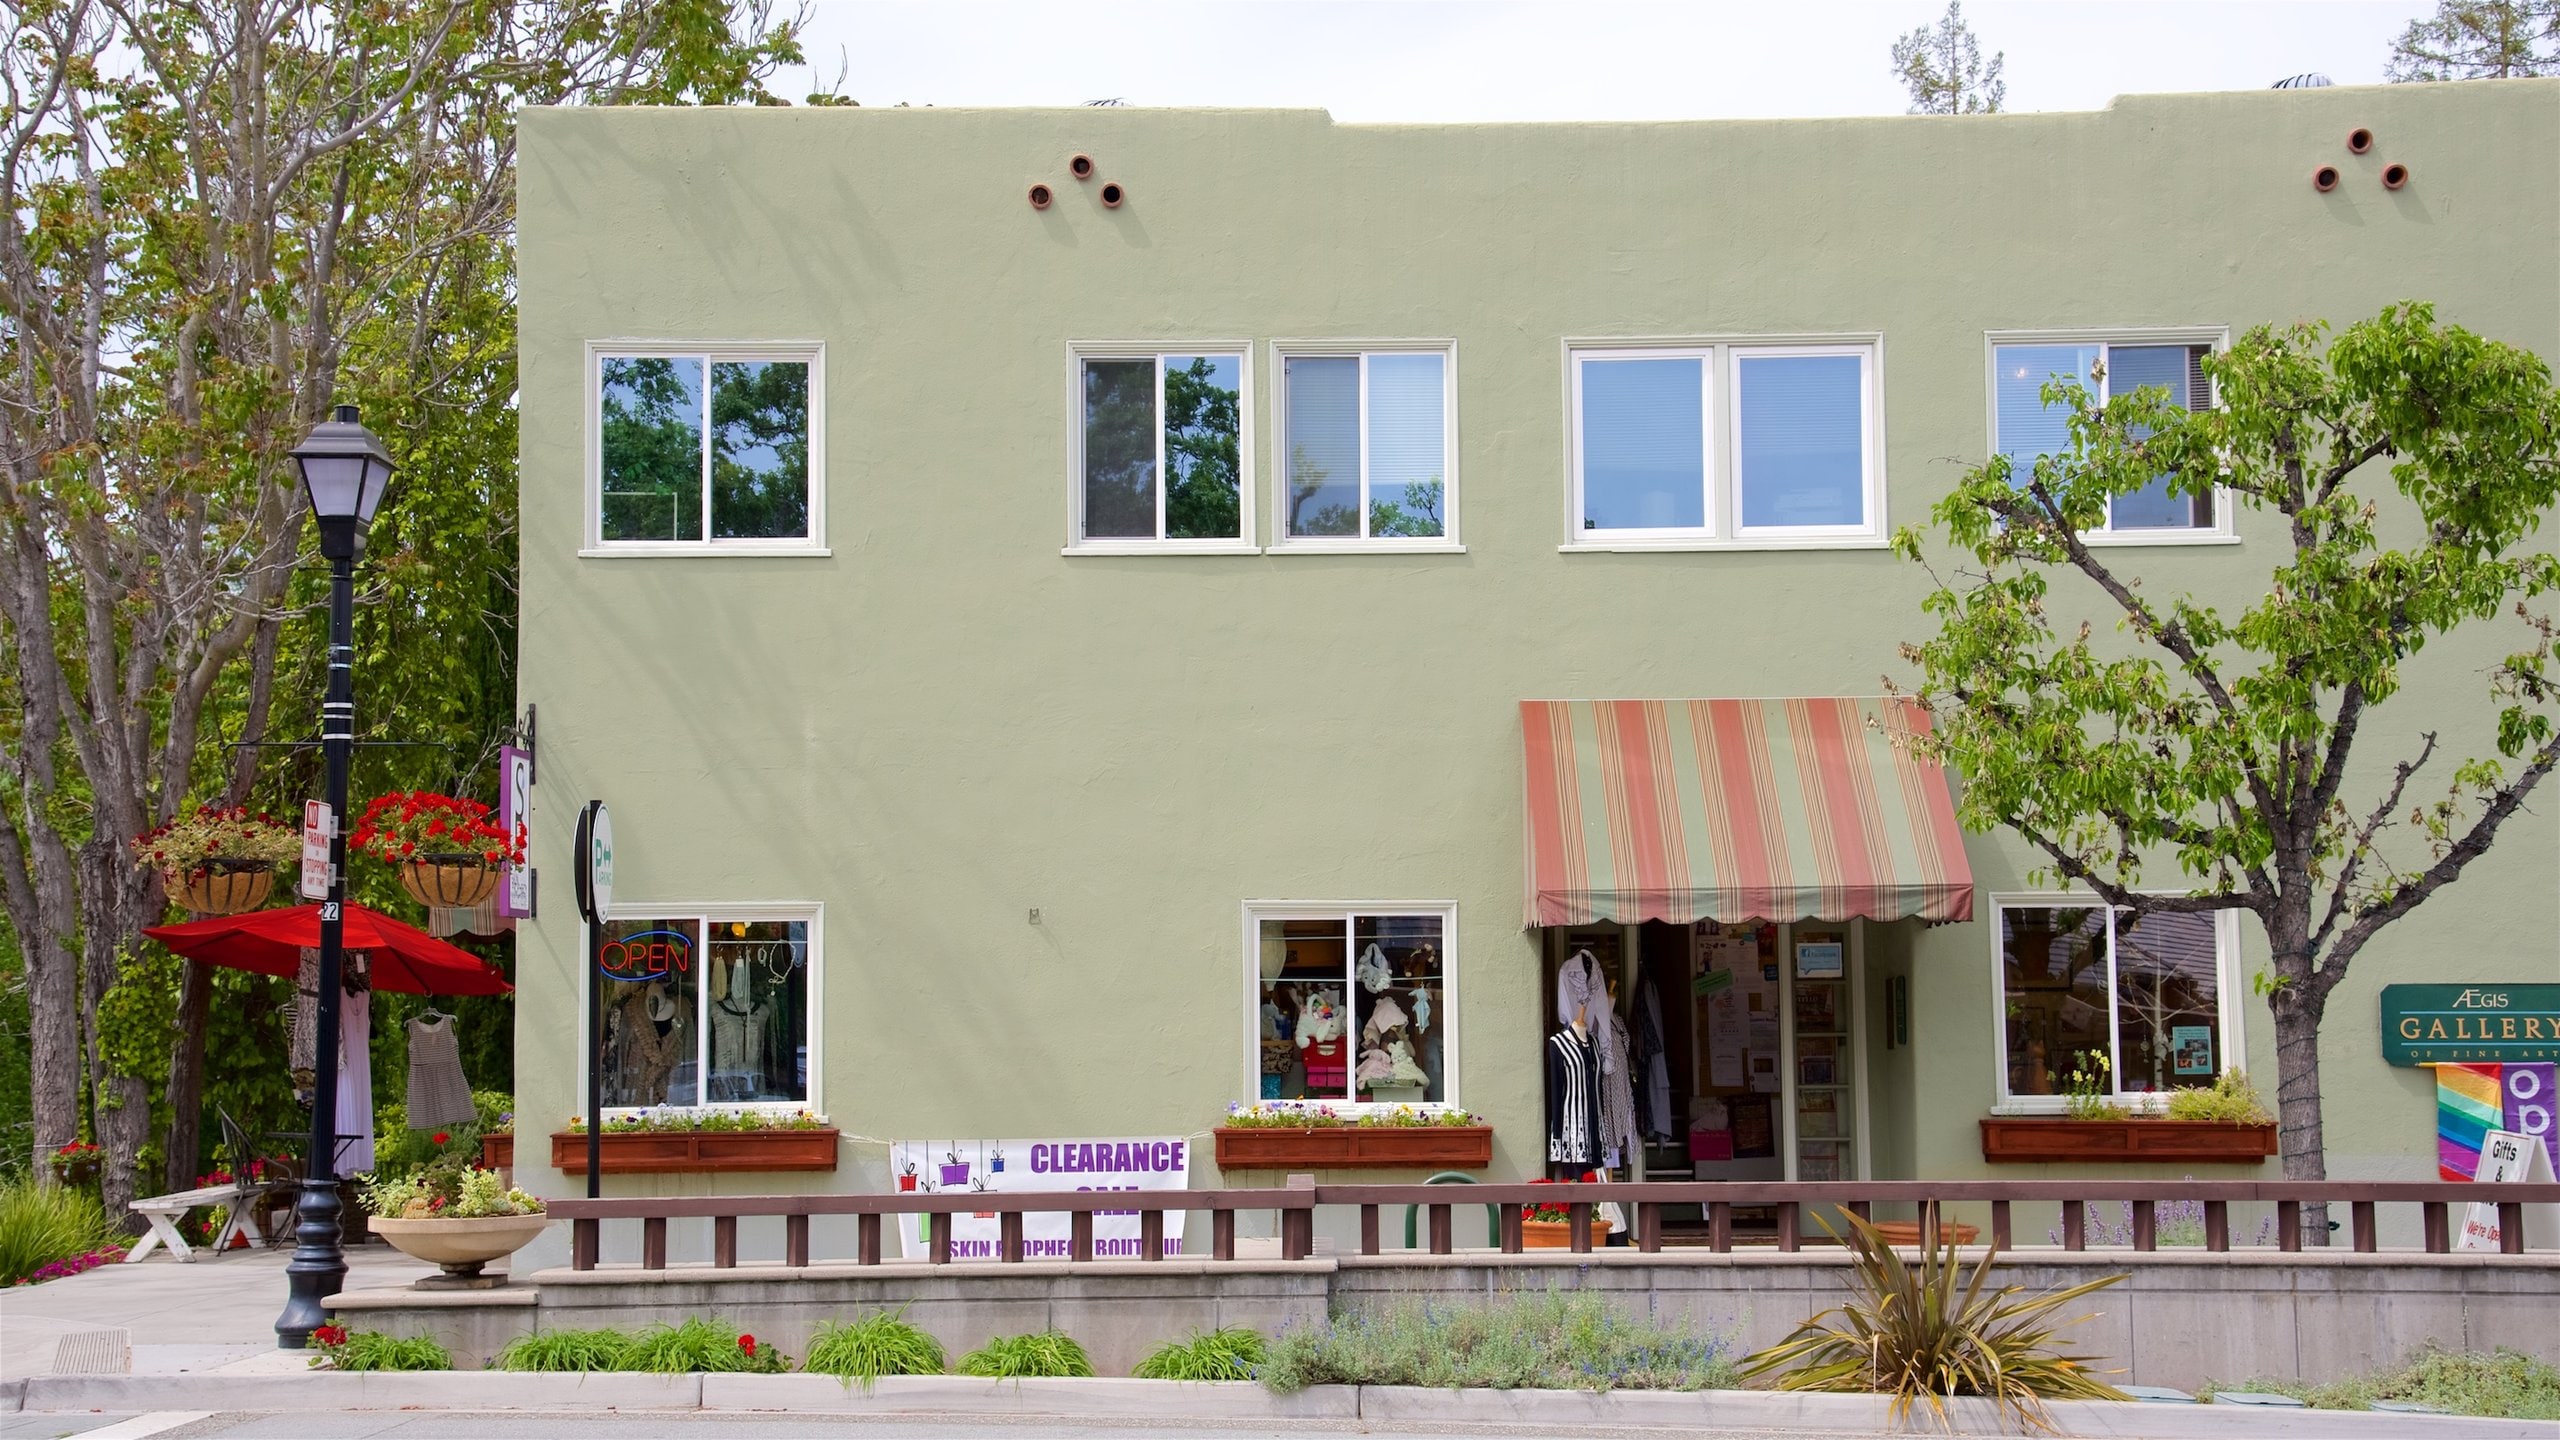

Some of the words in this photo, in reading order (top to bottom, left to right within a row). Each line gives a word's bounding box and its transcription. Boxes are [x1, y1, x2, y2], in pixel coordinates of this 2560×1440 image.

[307, 804, 318, 826] NO
[307, 831, 328, 849] PARKING
[306, 858, 327, 875] STOPPING
[600, 942, 689, 972] OPEN
[2400, 1017, 2560, 1039] GALLERY
[2411, 1050, 2431, 1058] OF
[2453, 1050, 2500, 1058] FINE
[2509, 1069, 2550, 1135] op
[1031, 1142, 1184, 1173] CLEARANCE
[2493, 1140, 2517, 1161] Gifts
[2495, 1165, 2504, 1182] &
[2467, 1220, 2487, 1238] We're
[2487, 1225, 2501, 1243] Ope
[950, 1240, 990, 1257] SKIN
